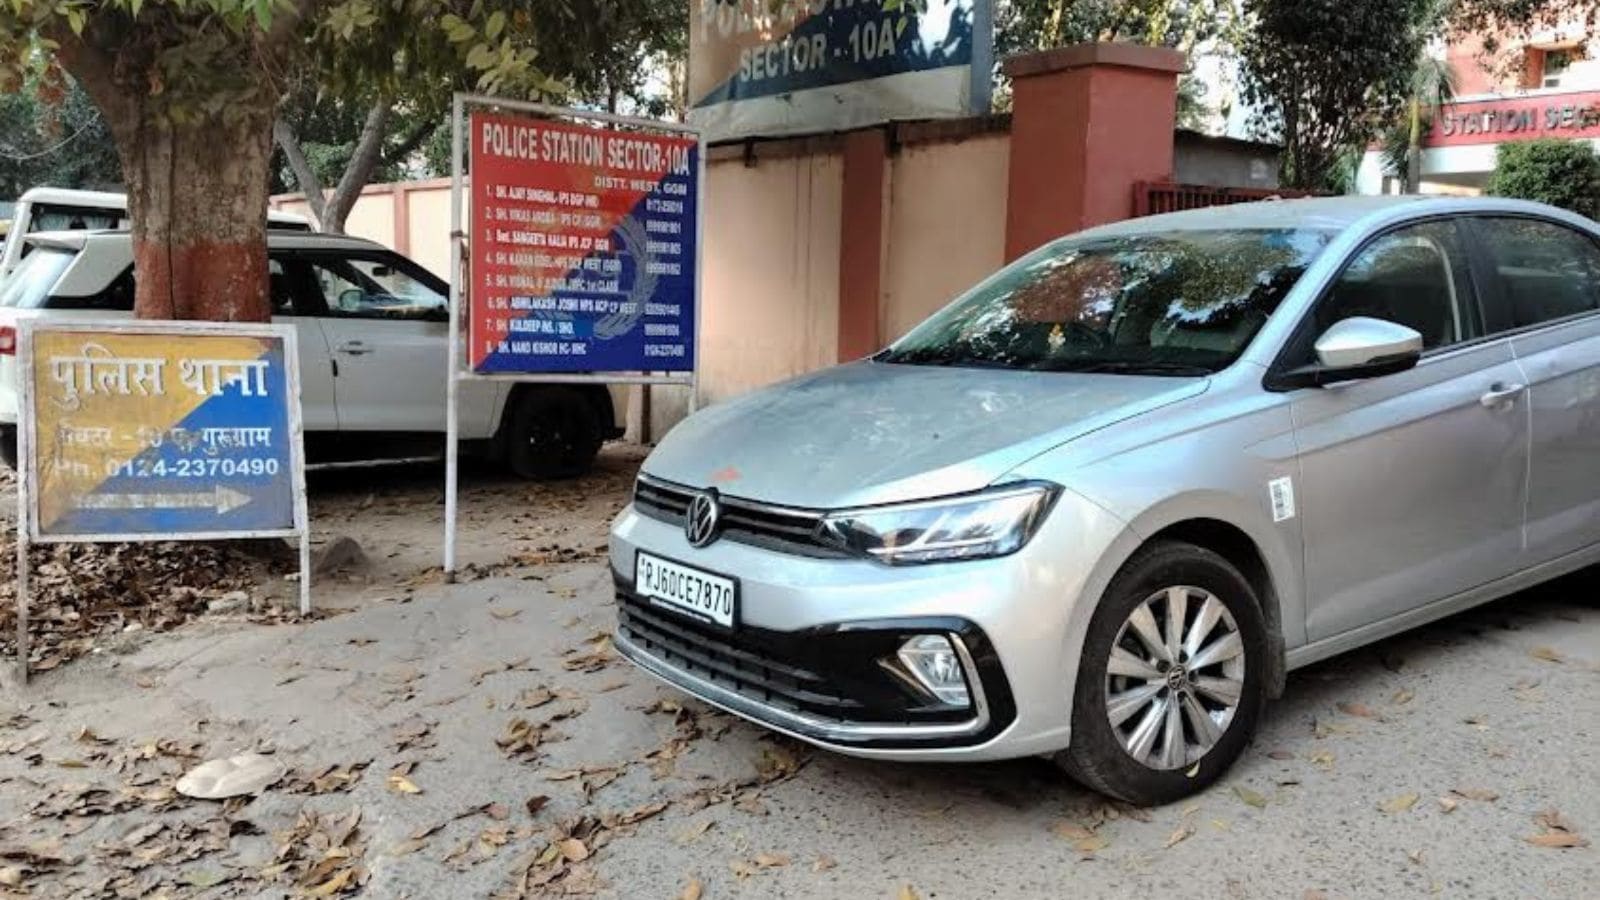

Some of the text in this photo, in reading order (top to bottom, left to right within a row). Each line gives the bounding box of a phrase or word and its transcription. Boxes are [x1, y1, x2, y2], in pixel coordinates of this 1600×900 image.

[740, 33, 827, 82] SECTOR
[849, 19, 896, 63] 10A
[1442, 103, 1600, 136] STATION SEC
[482, 122, 691, 176] POLICE STATION SECTOR-10A
[50, 342, 270, 411] पुलिस थाना
[105, 457, 279, 478] 0124-2370490
[645, 561, 732, 616] RJ60CE7870
